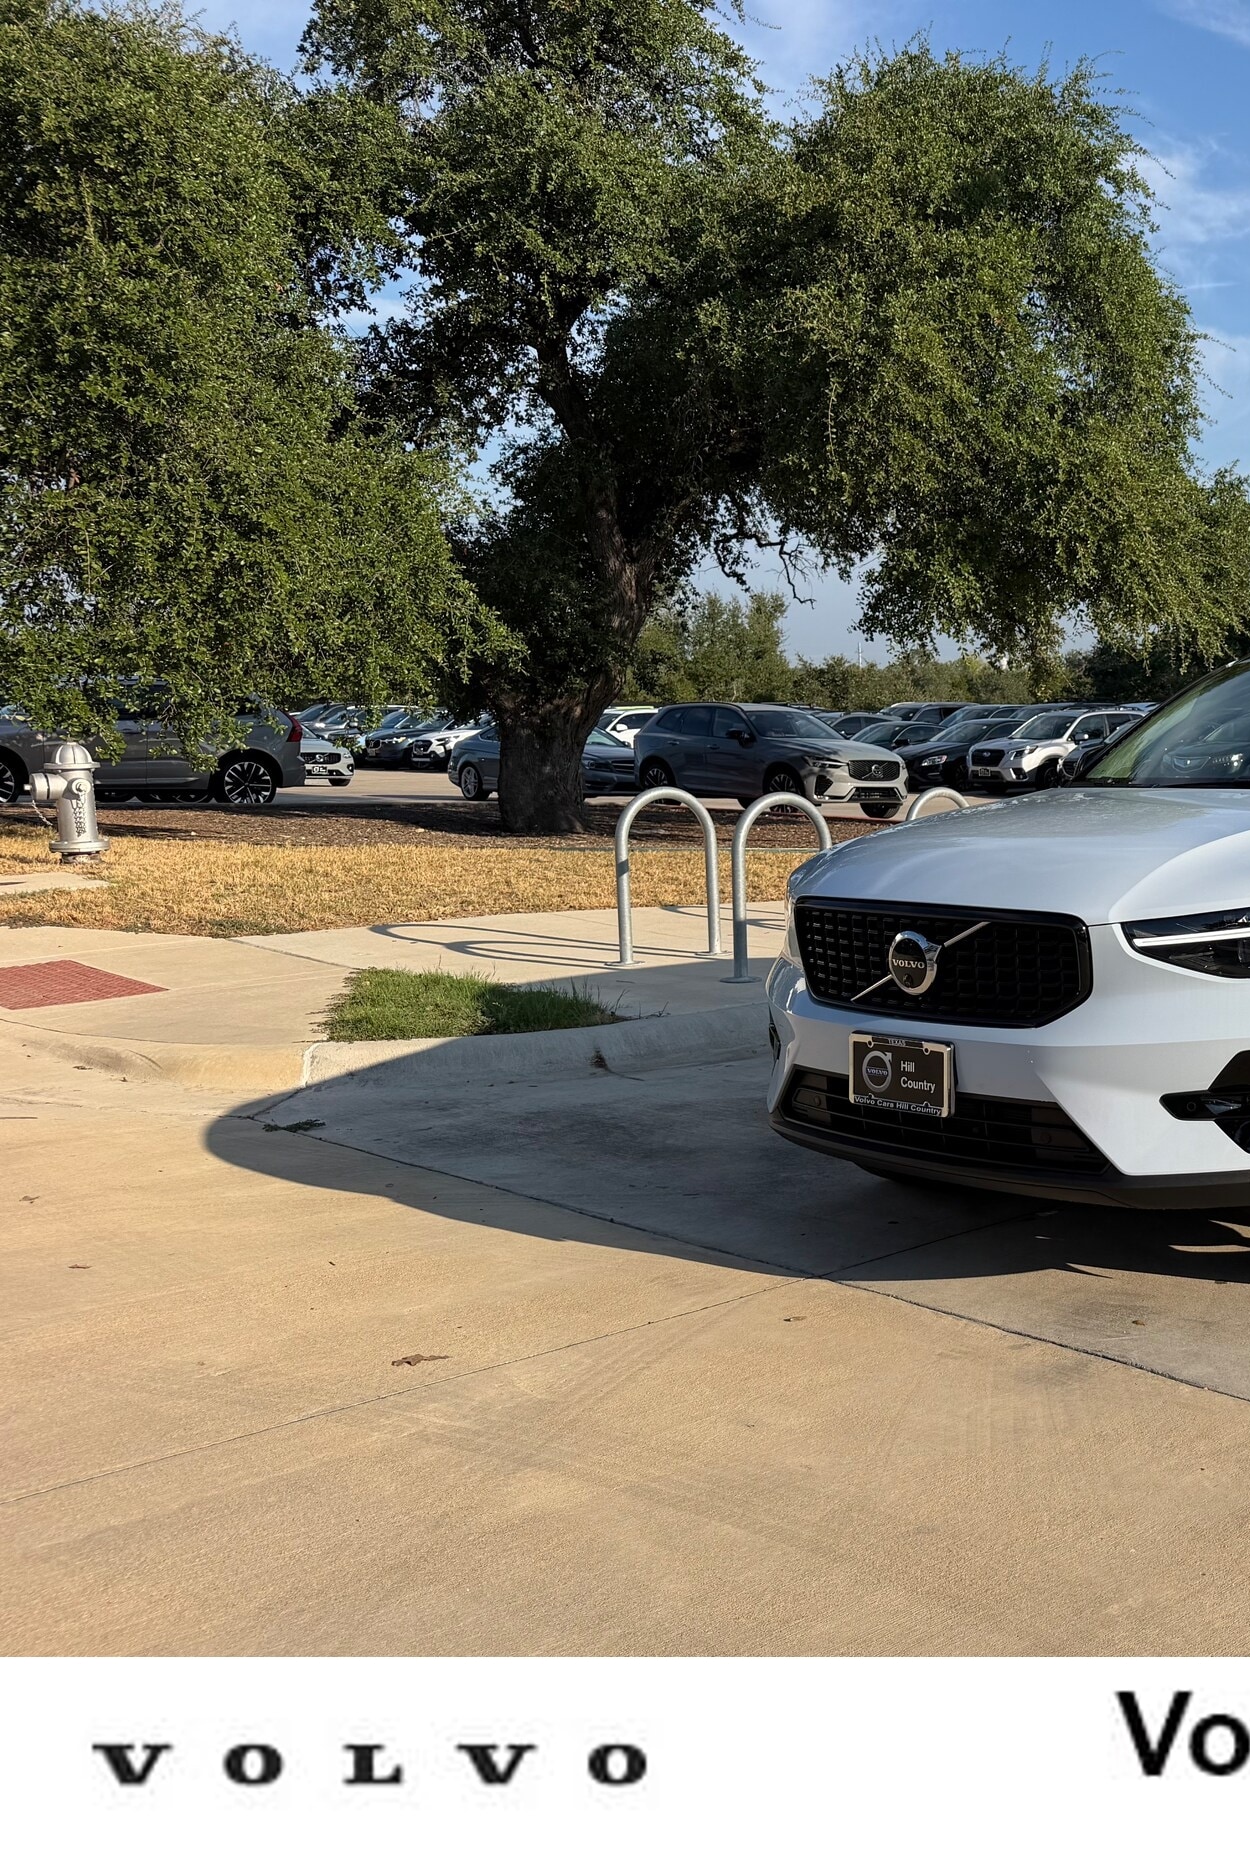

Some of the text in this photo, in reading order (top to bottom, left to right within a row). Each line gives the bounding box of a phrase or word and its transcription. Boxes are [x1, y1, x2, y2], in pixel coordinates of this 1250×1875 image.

[892, 958, 926, 969] VOLVO
[887, 1038, 906, 1047] TEXAS
[866, 1068, 888, 1076] VOLVO
[900, 1060, 915, 1073] Hill
[900, 1076, 936, 1094] Country
[854, 1095, 941, 1116] Volvo Cars Hill Country
